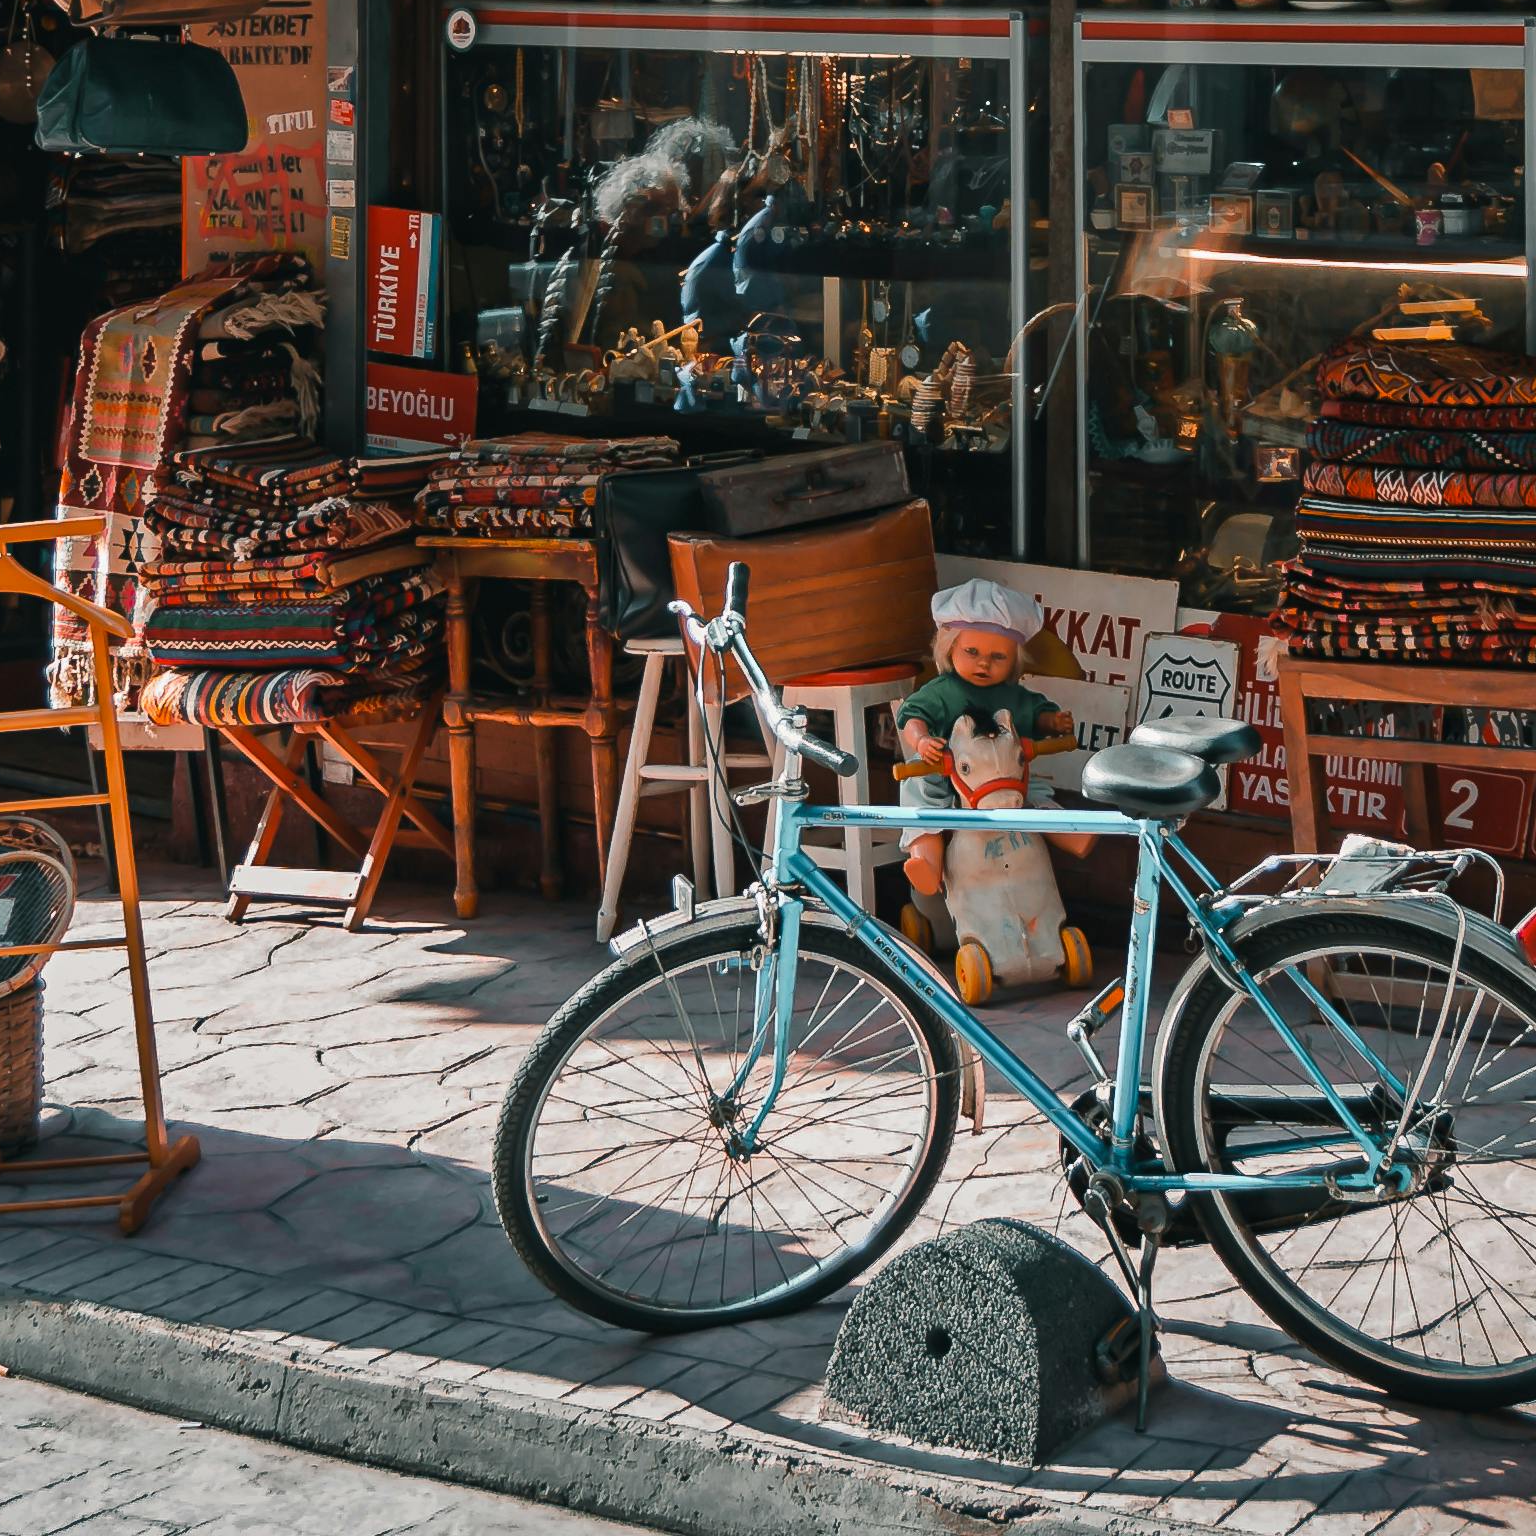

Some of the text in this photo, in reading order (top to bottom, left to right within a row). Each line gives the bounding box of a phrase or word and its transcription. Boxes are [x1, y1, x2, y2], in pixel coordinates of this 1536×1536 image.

[372, 244, 400, 343] TÜRKİYE
[366, 386, 454, 422] BEYOĞLU
[1160, 668, 1217, 694] ROUTE
[1444, 779, 1479, 829] 2
